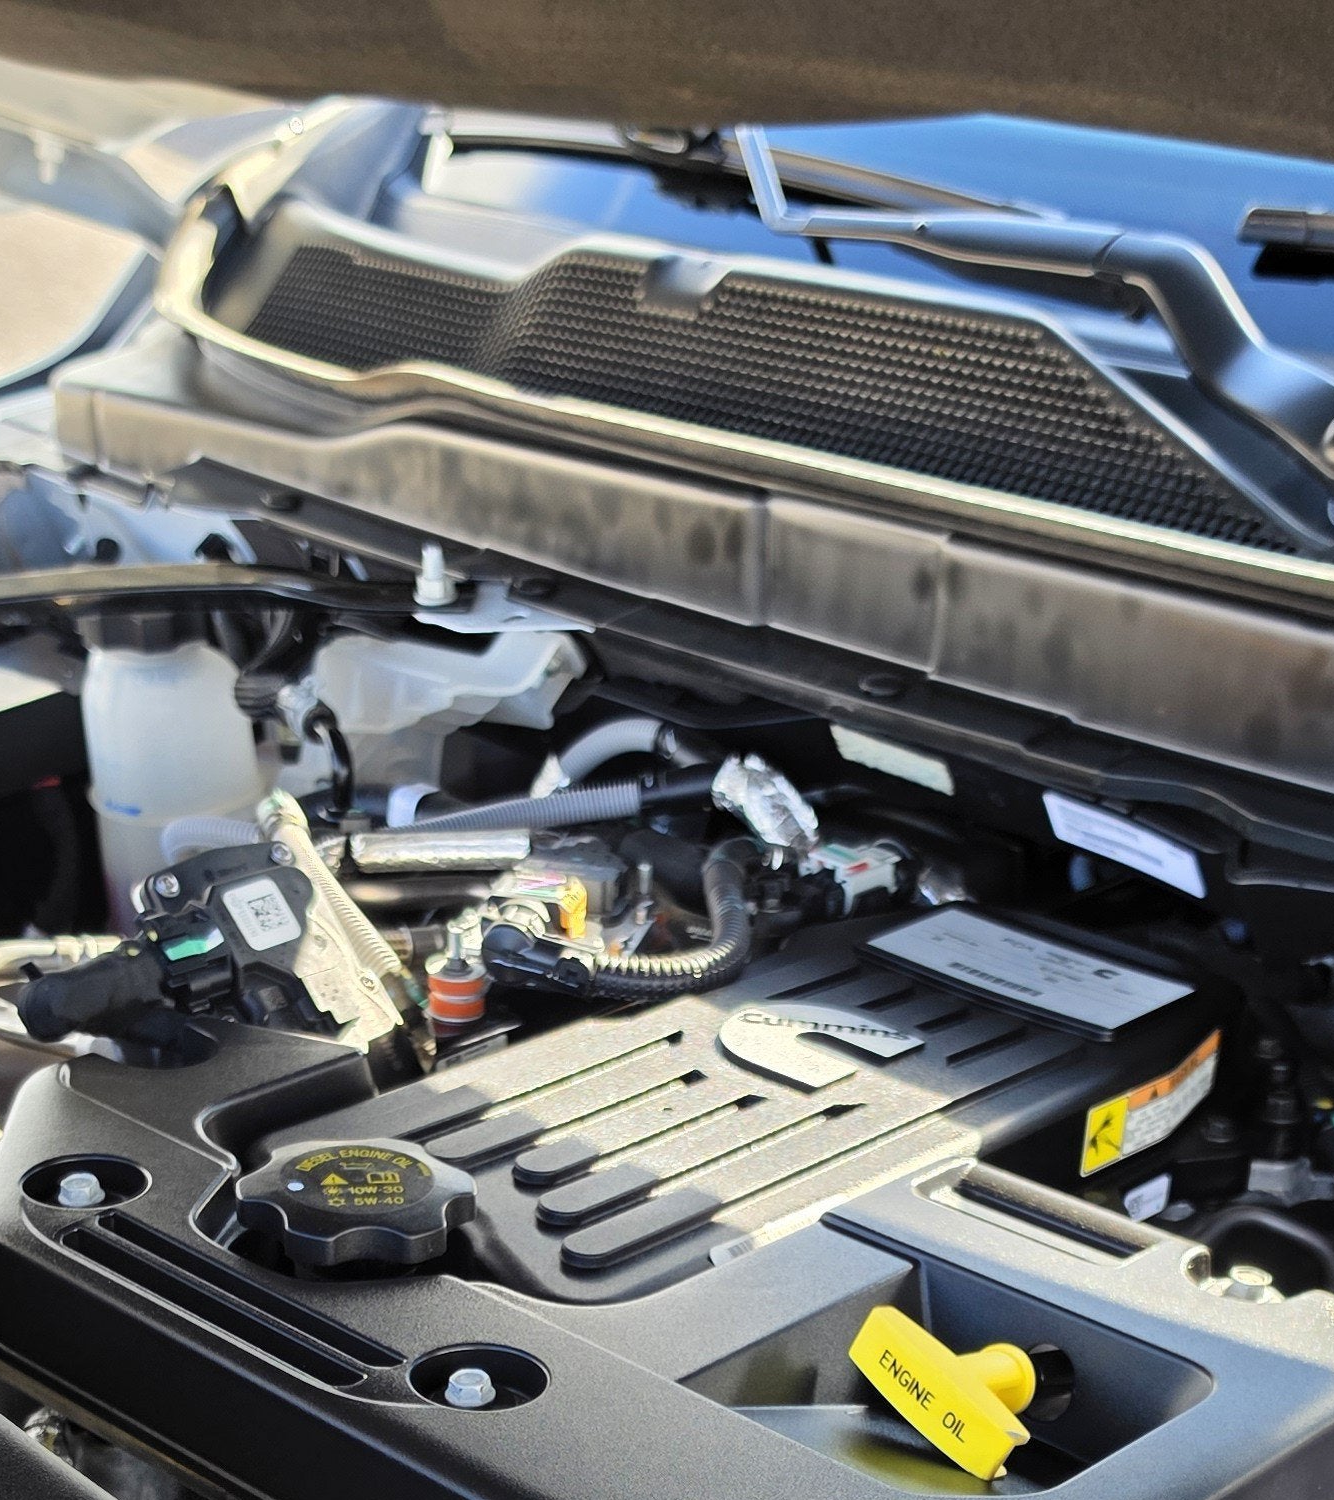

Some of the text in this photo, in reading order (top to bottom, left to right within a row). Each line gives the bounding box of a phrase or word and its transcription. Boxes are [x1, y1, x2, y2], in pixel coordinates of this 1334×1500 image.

[739, 1010, 912, 1041] Cummins
[339, 1149, 394, 1160] ENGINE
[392, 1153, 414, 1169] OIL
[348, 1185, 405, 1196] 10W-30
[353, 1196, 405, 1207] 5W-40
[878, 1349, 966, 1444] ENGINE OIL
